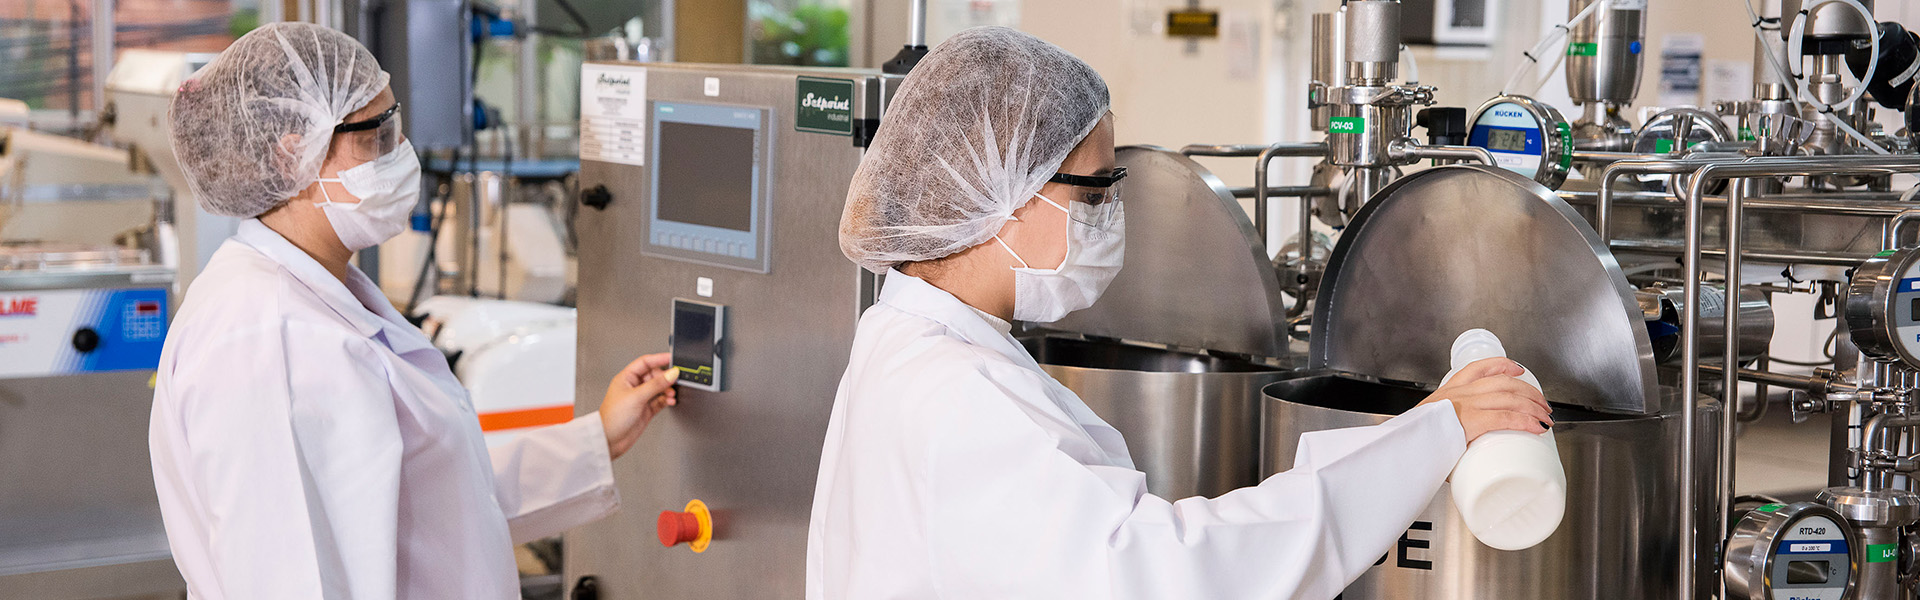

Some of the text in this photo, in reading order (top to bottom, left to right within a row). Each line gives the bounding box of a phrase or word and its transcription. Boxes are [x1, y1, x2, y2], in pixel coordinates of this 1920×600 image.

[802, 92, 849, 111] Setpoint
[1330, 121, 1354, 130] PCV-03
[1799, 527, 1826, 535] RTD-420
